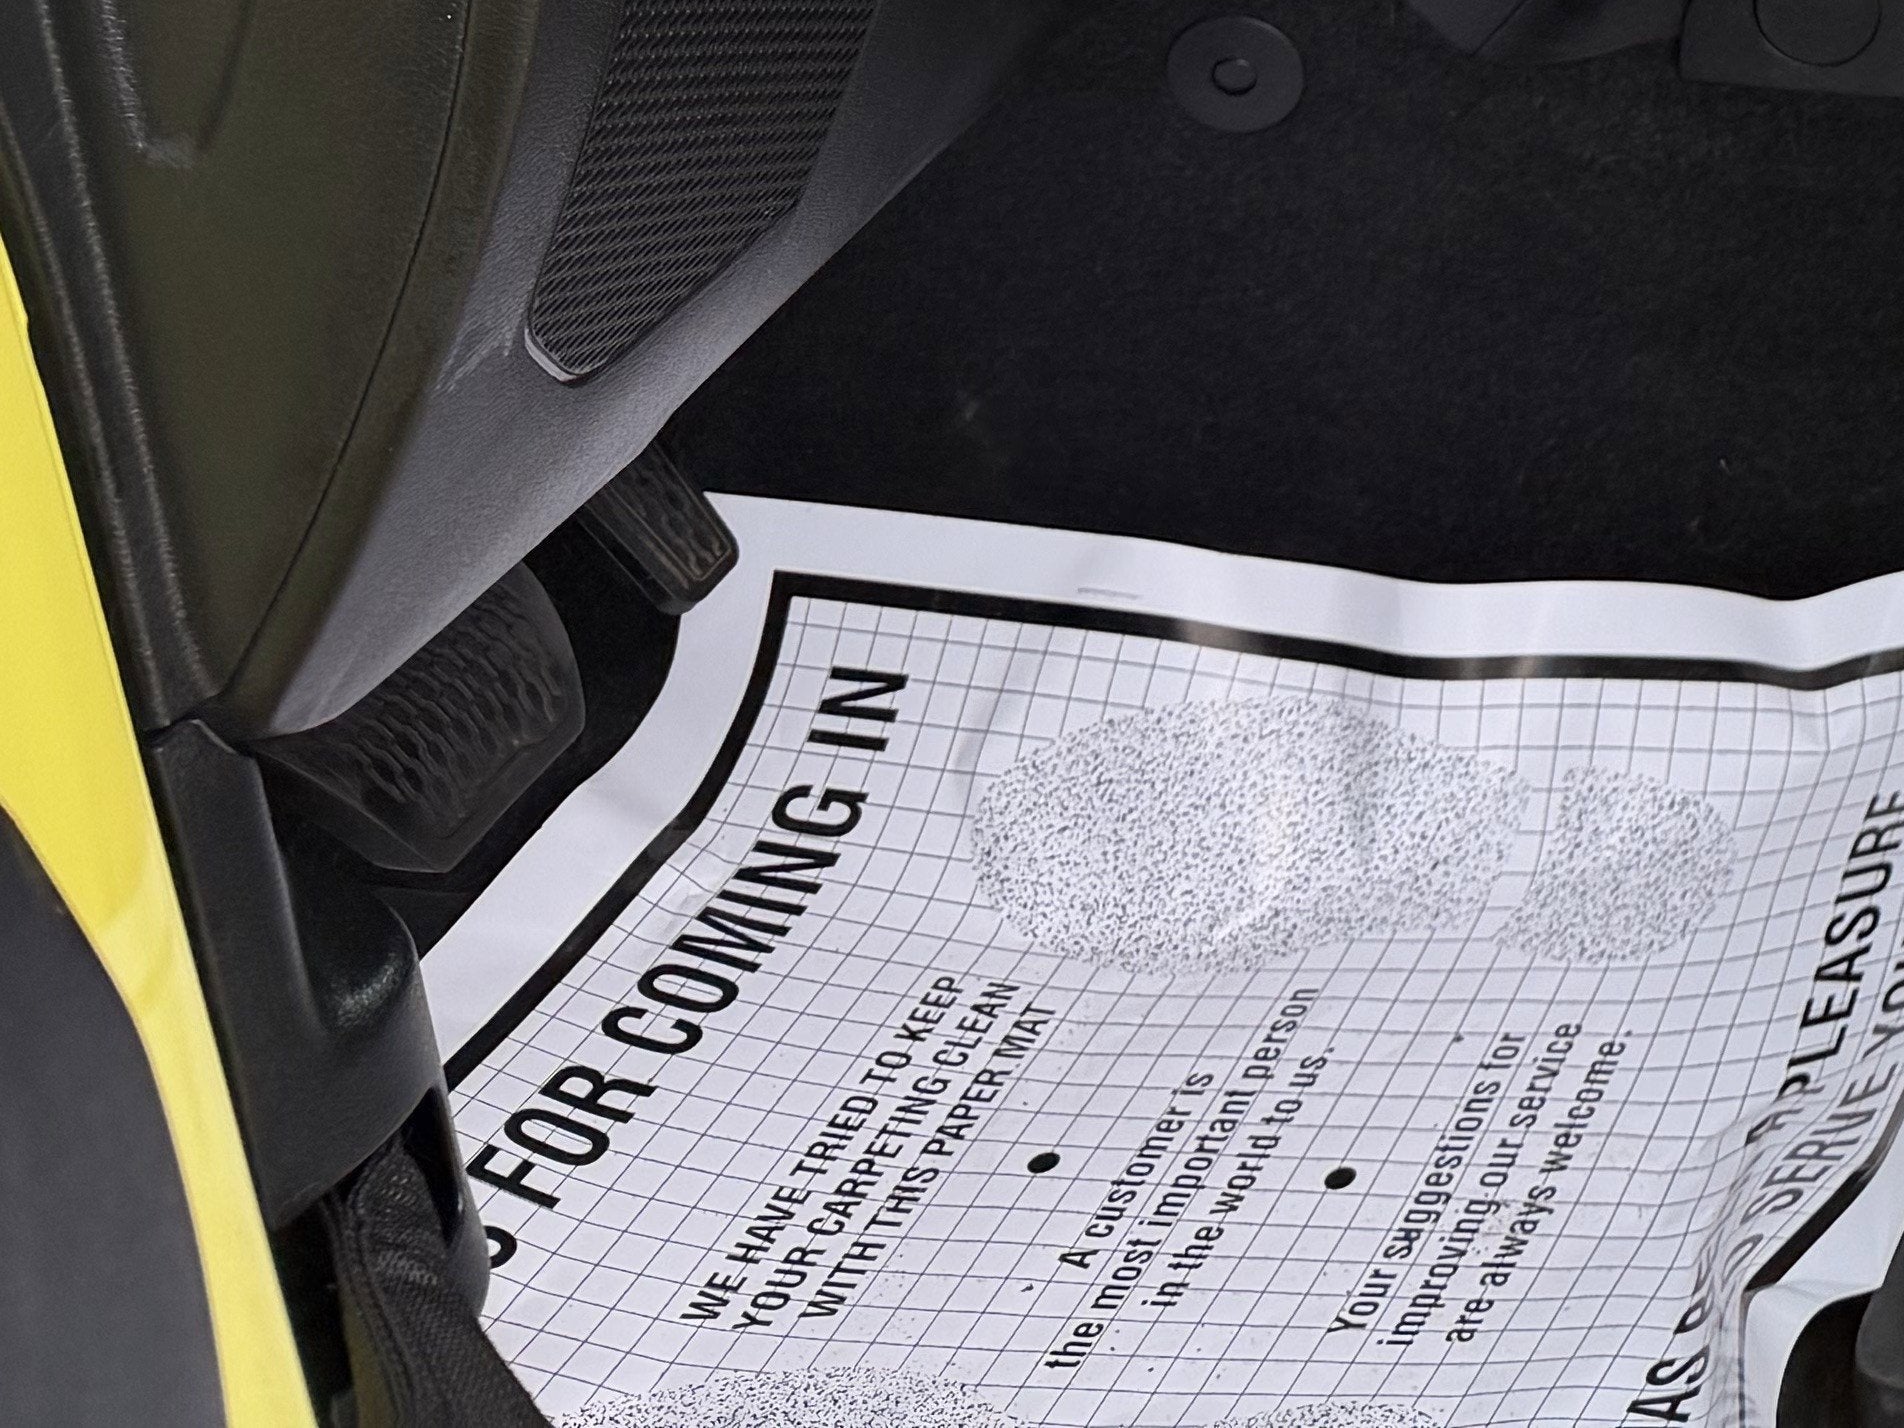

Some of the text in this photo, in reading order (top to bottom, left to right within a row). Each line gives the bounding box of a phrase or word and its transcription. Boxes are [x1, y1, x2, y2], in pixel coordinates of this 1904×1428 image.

[466, 665, 909, 1211] FOR COMING IN
[680, 976, 965, 1319] WE HAVE TRIED TO KEEP
[732, 982, 1022, 1330] YOUR CARPETING CLEAN
[798, 1002, 1057, 1318] WITH THIS PAPER MAT
[1045, 988, 1320, 1369] the most important person
[1059, 1072, 1215, 1269] A customer is
[1141, 1047, 1336, 1307] in the world to us.
[1327, 1033, 1526, 1333] Your suggestions for
[1377, 1022, 1582, 1346] improving our service
[1445, 1030, 1634, 1343] are always welcome.
[1741, 1062, 1899, 1224] SERVE
